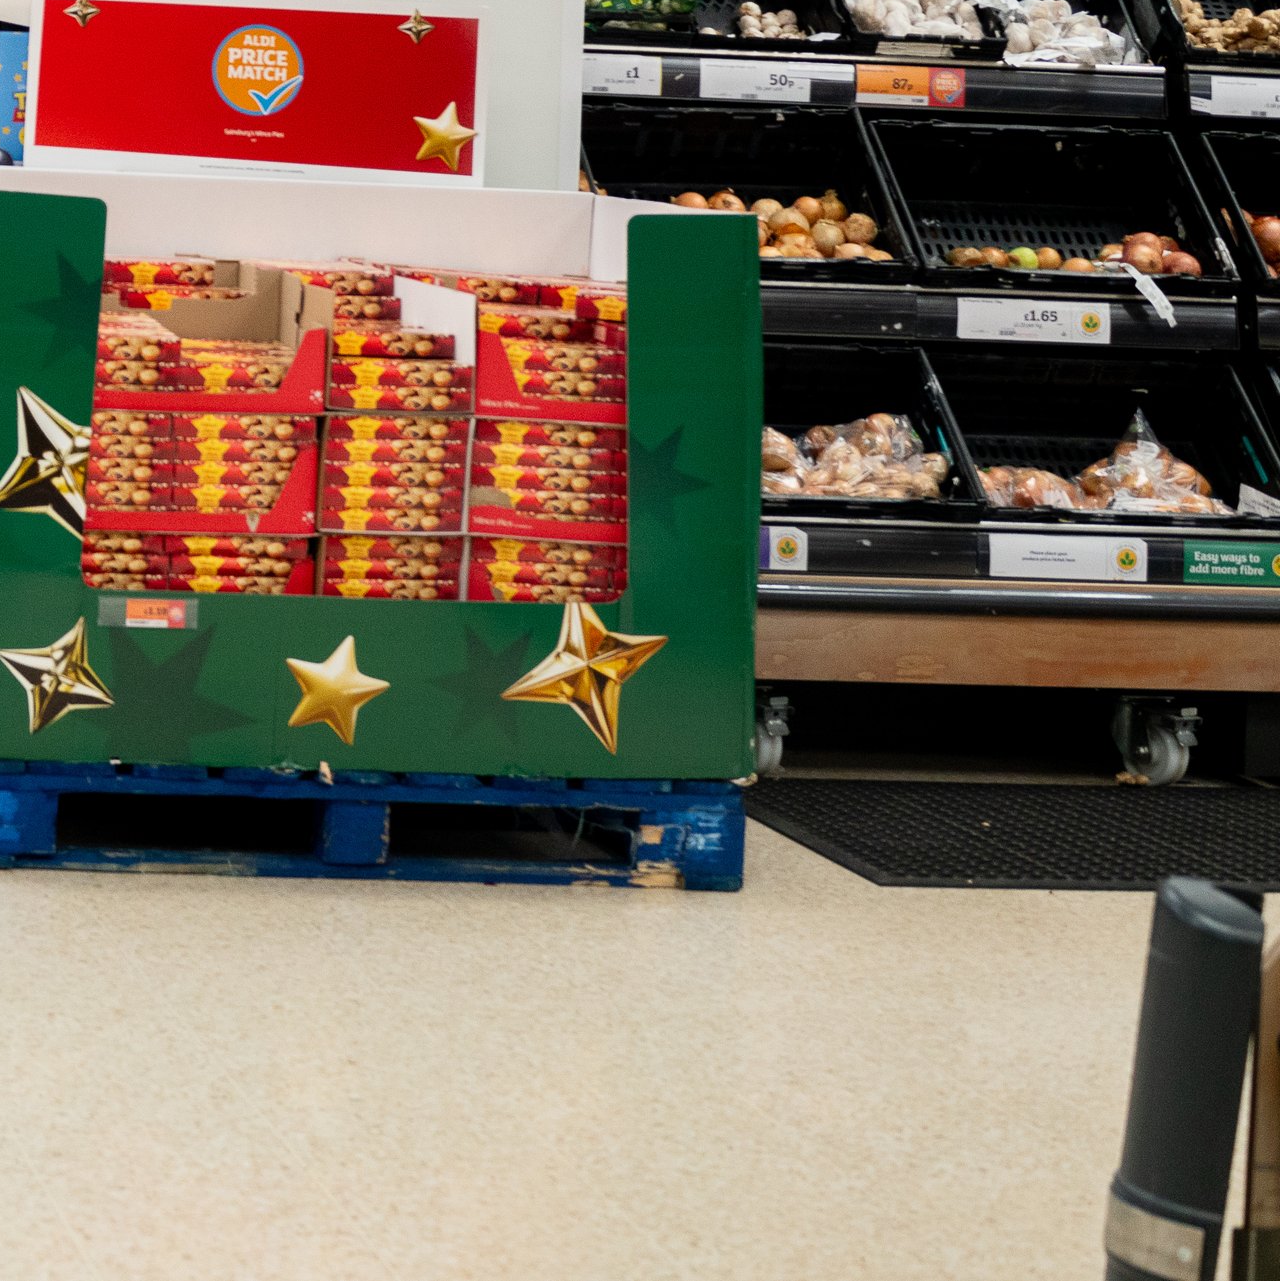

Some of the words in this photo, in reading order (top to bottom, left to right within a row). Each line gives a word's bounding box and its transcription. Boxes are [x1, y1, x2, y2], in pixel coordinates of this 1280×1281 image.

[243, 34, 276, 48] ALDI
[228, 48, 288, 66] PRICE
[228, 64, 287, 82] MATCH
[626, 66, 640, 80] £1
[768, 72, 796, 88] 50p
[892, 78, 914, 92] 87p
[1024, 310, 1058, 322] £1.65
[1194, 551, 1218, 564] Easy
[1222, 553, 1248, 565] ways
[1251, 554, 1260, 563] to
[1190, 563, 1210, 574] add
[1214, 565, 1239, 575] more
[1242, 564, 1265, 576] fibre
